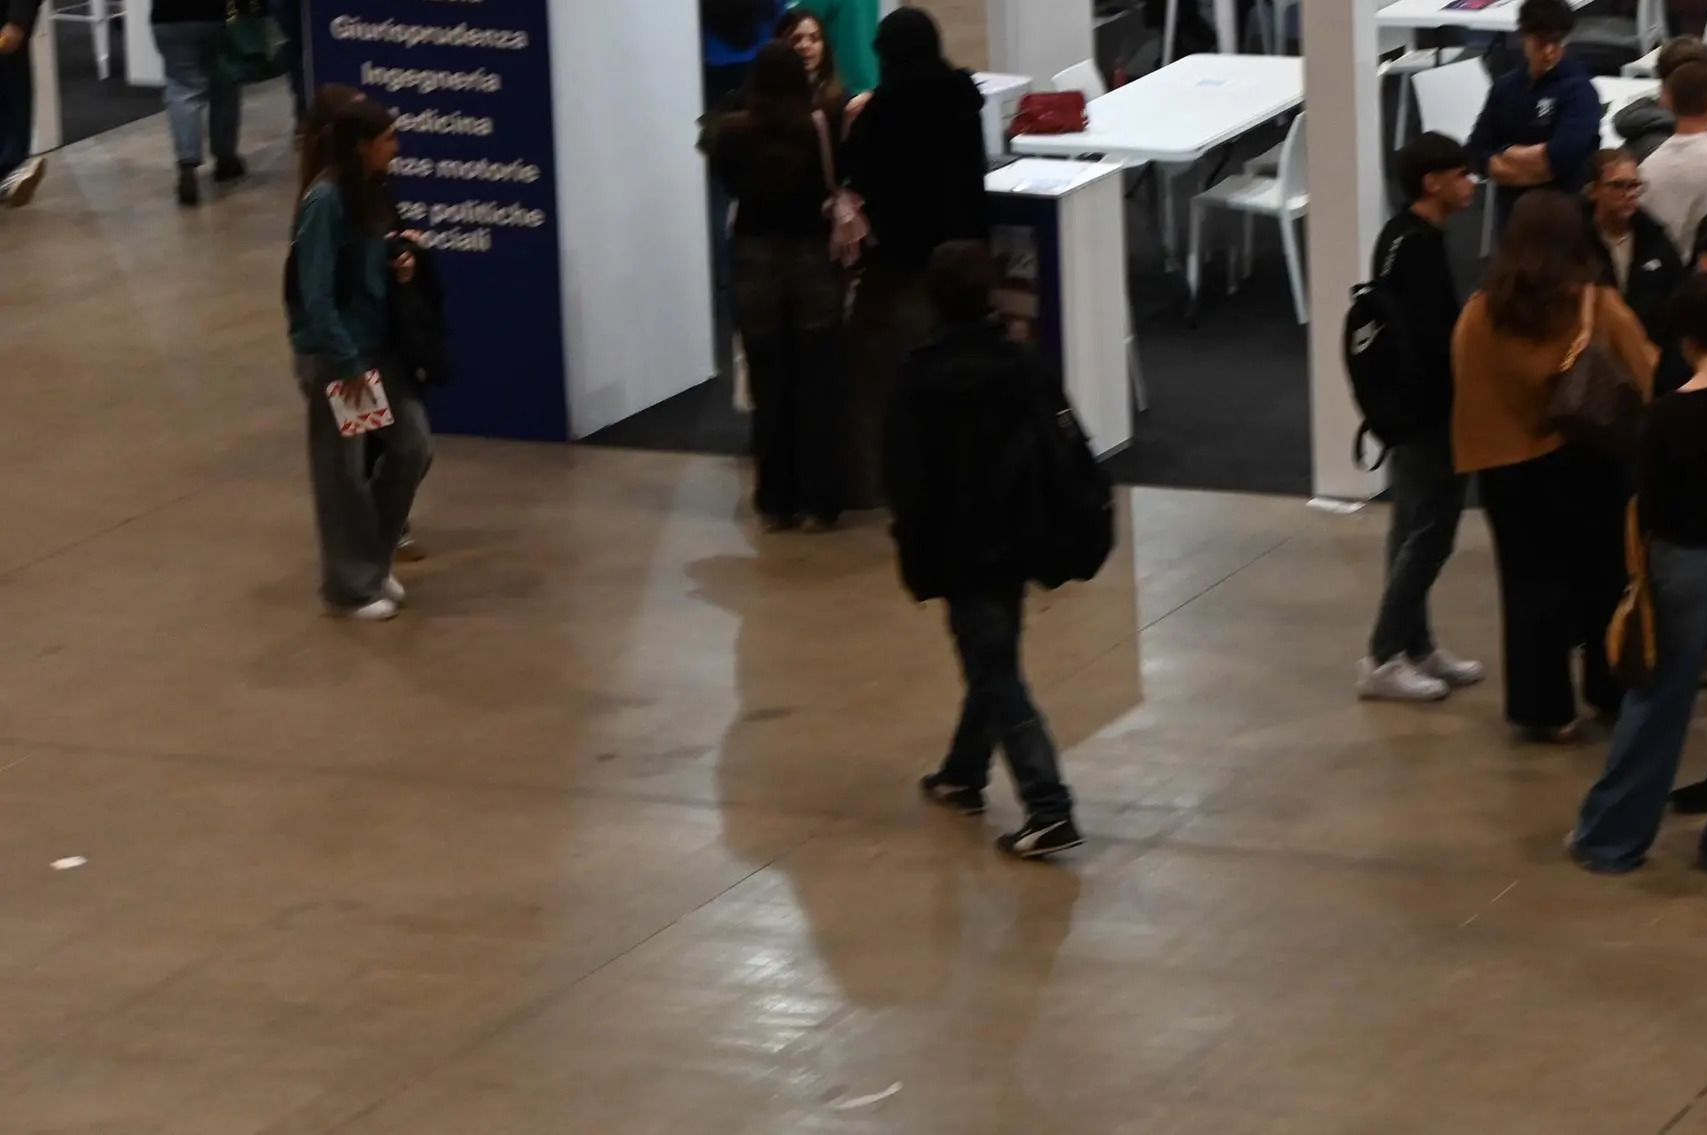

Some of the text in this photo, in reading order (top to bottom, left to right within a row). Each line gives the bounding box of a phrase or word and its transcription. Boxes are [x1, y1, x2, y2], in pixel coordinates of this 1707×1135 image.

[329, 14, 529, 50] Giurisprudenza
[360, 61, 501, 94] Ingegneria
[435, 158, 541, 184] motorie
[428, 199, 546, 228] politiche
